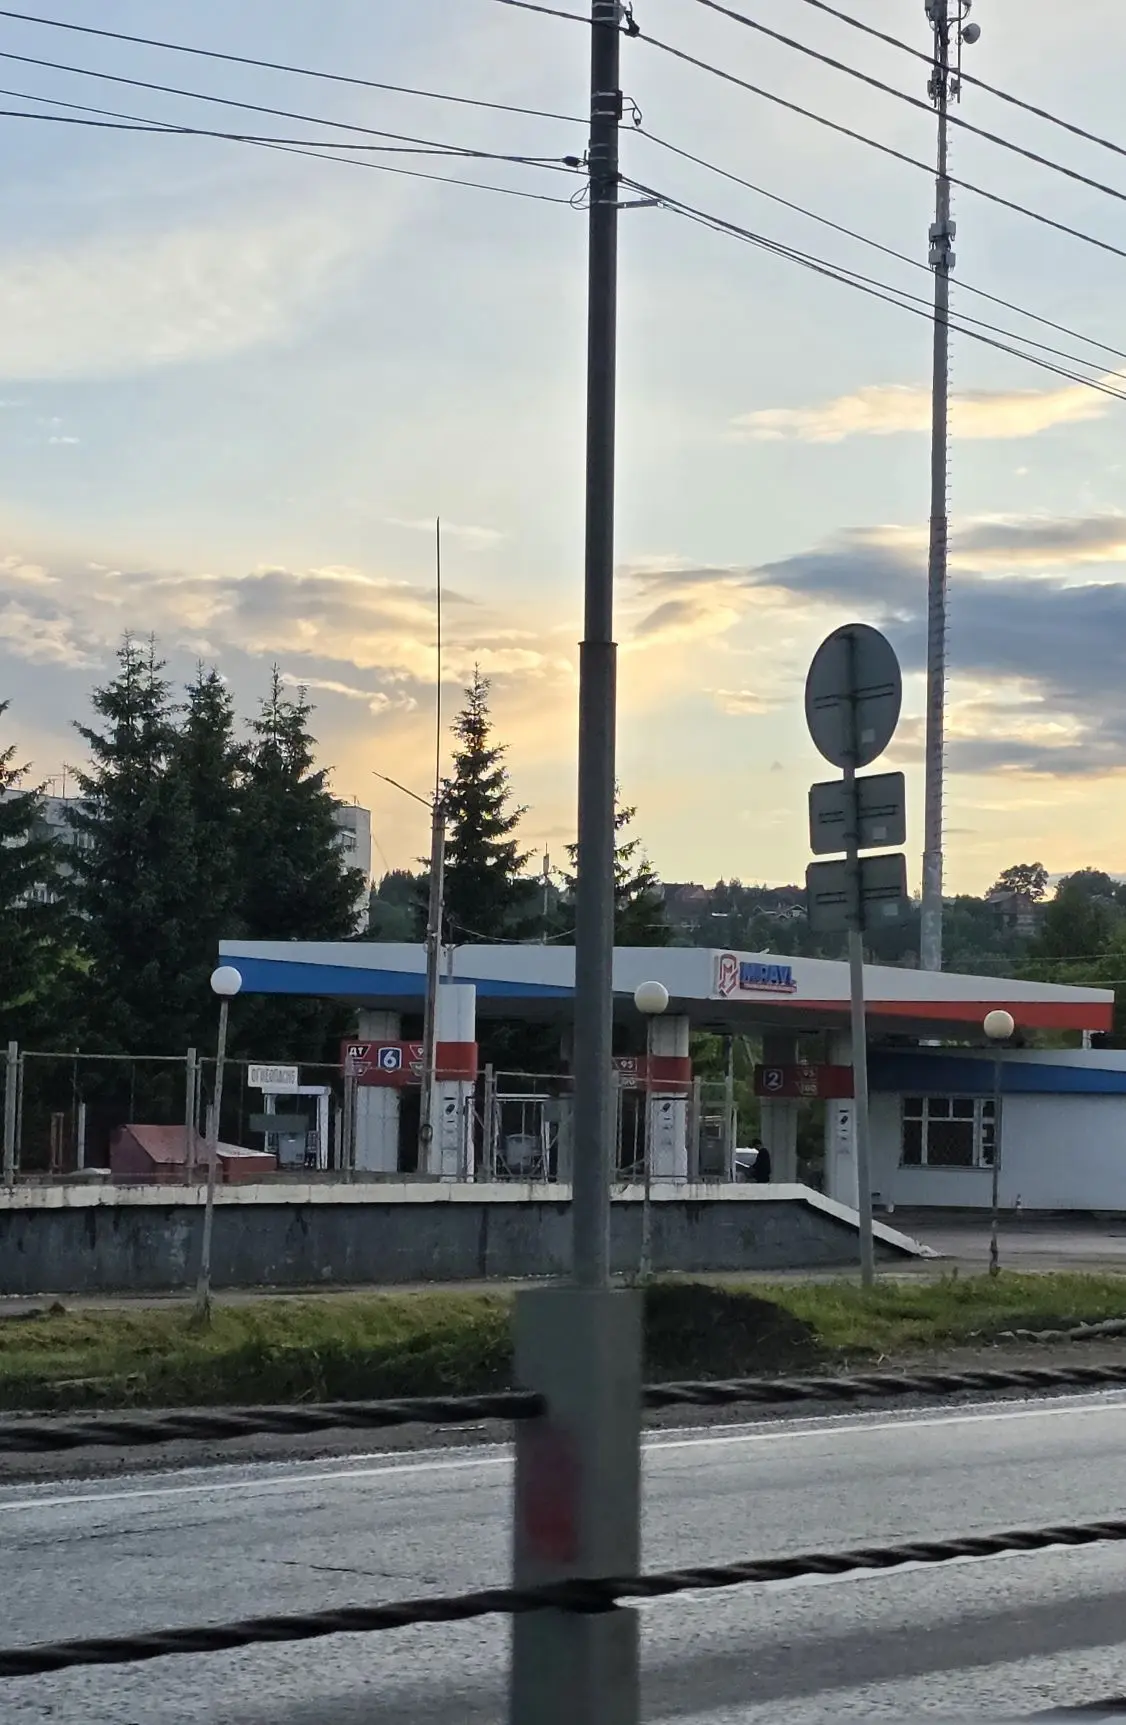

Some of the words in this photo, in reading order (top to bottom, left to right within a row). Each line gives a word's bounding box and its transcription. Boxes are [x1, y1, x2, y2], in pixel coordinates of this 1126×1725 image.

[384, 1050, 396, 1068] 6
[620, 1060, 633, 1069] 95
[767, 1071, 779, 1086] 2
